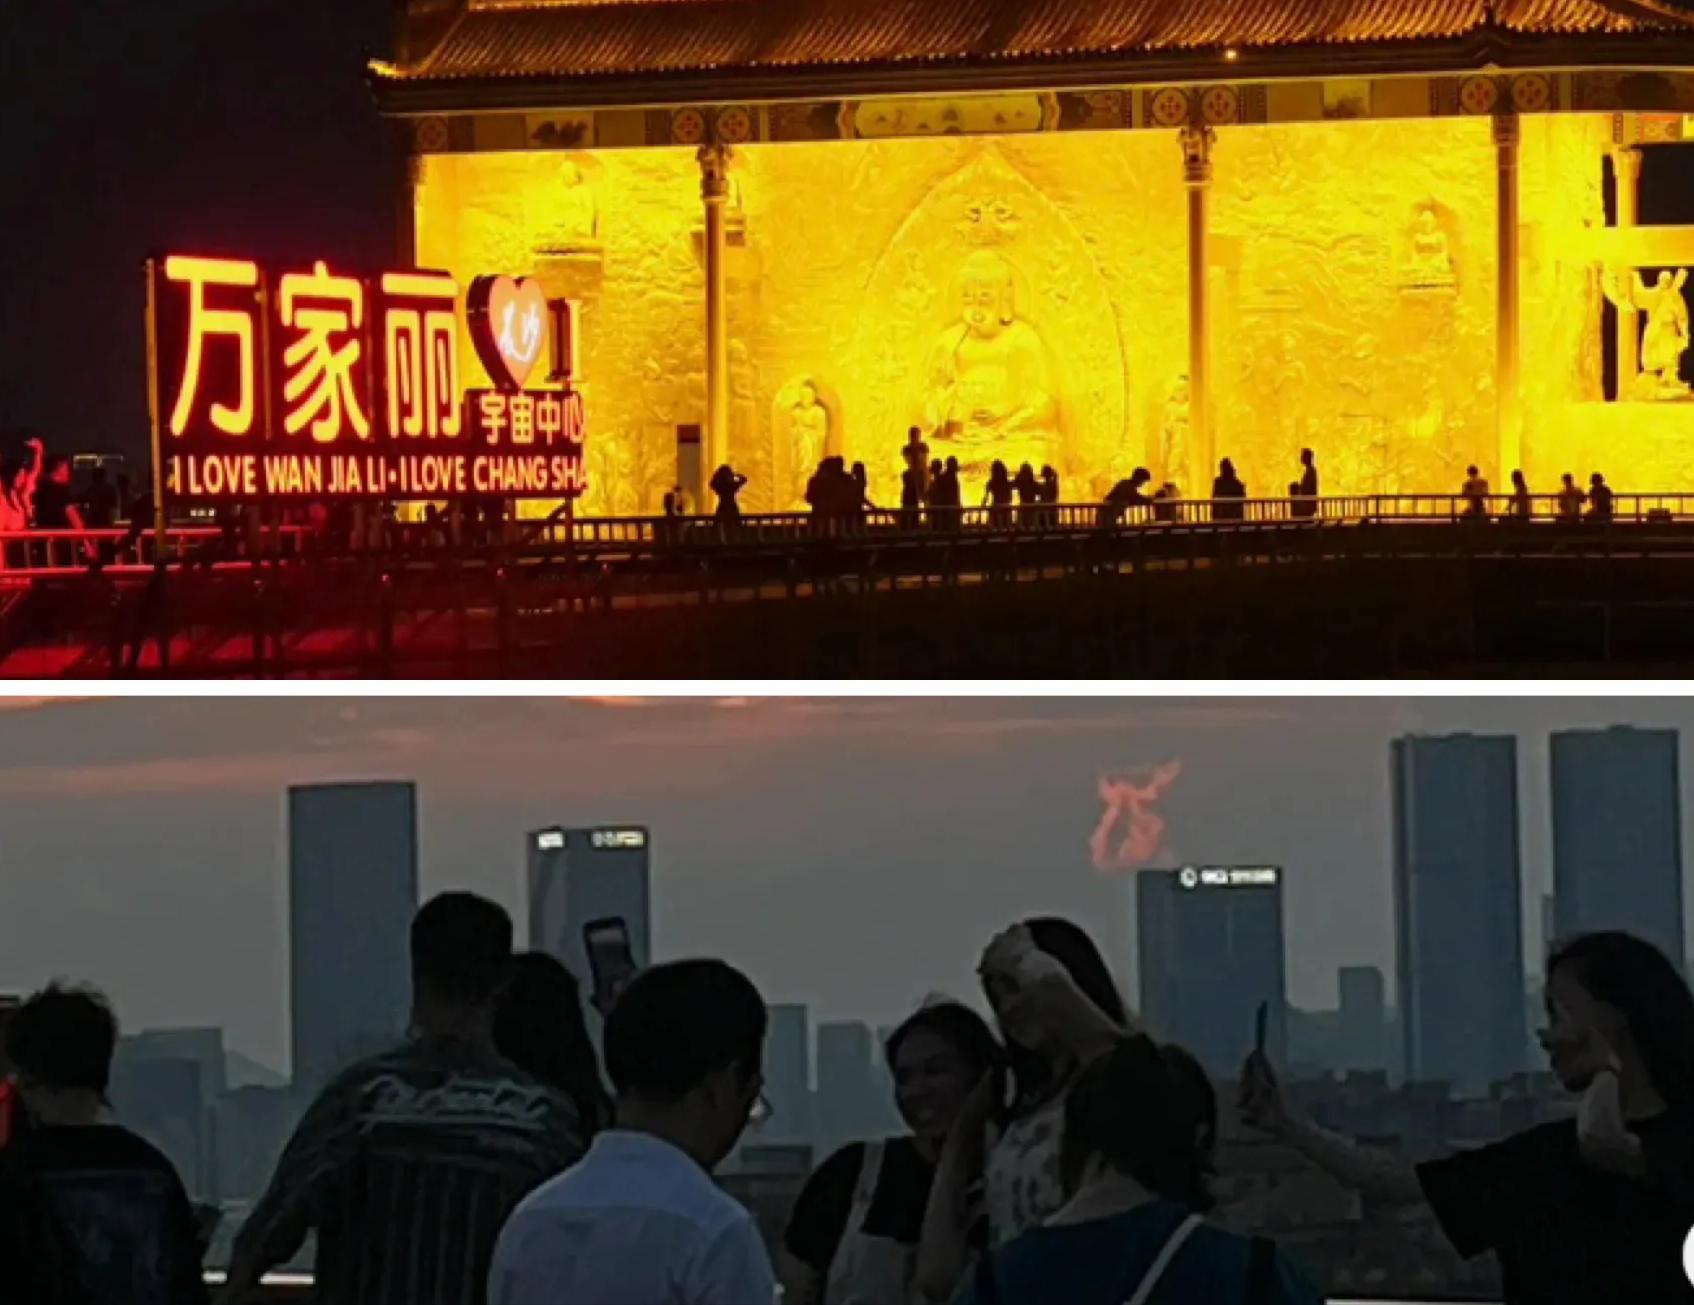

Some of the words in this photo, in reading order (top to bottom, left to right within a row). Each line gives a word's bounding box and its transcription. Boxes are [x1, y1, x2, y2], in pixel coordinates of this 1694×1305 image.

[166, 256, 462, 442] 万家丽
[481, 391, 584, 444] 宇宙中心
[187, 455, 257, 494] LOVE
[263, 455, 322, 494] WAN
[328, 455, 363, 493] JIA
[410, 455, 466, 492] LOVE
[473, 455, 548, 491] CHANG
